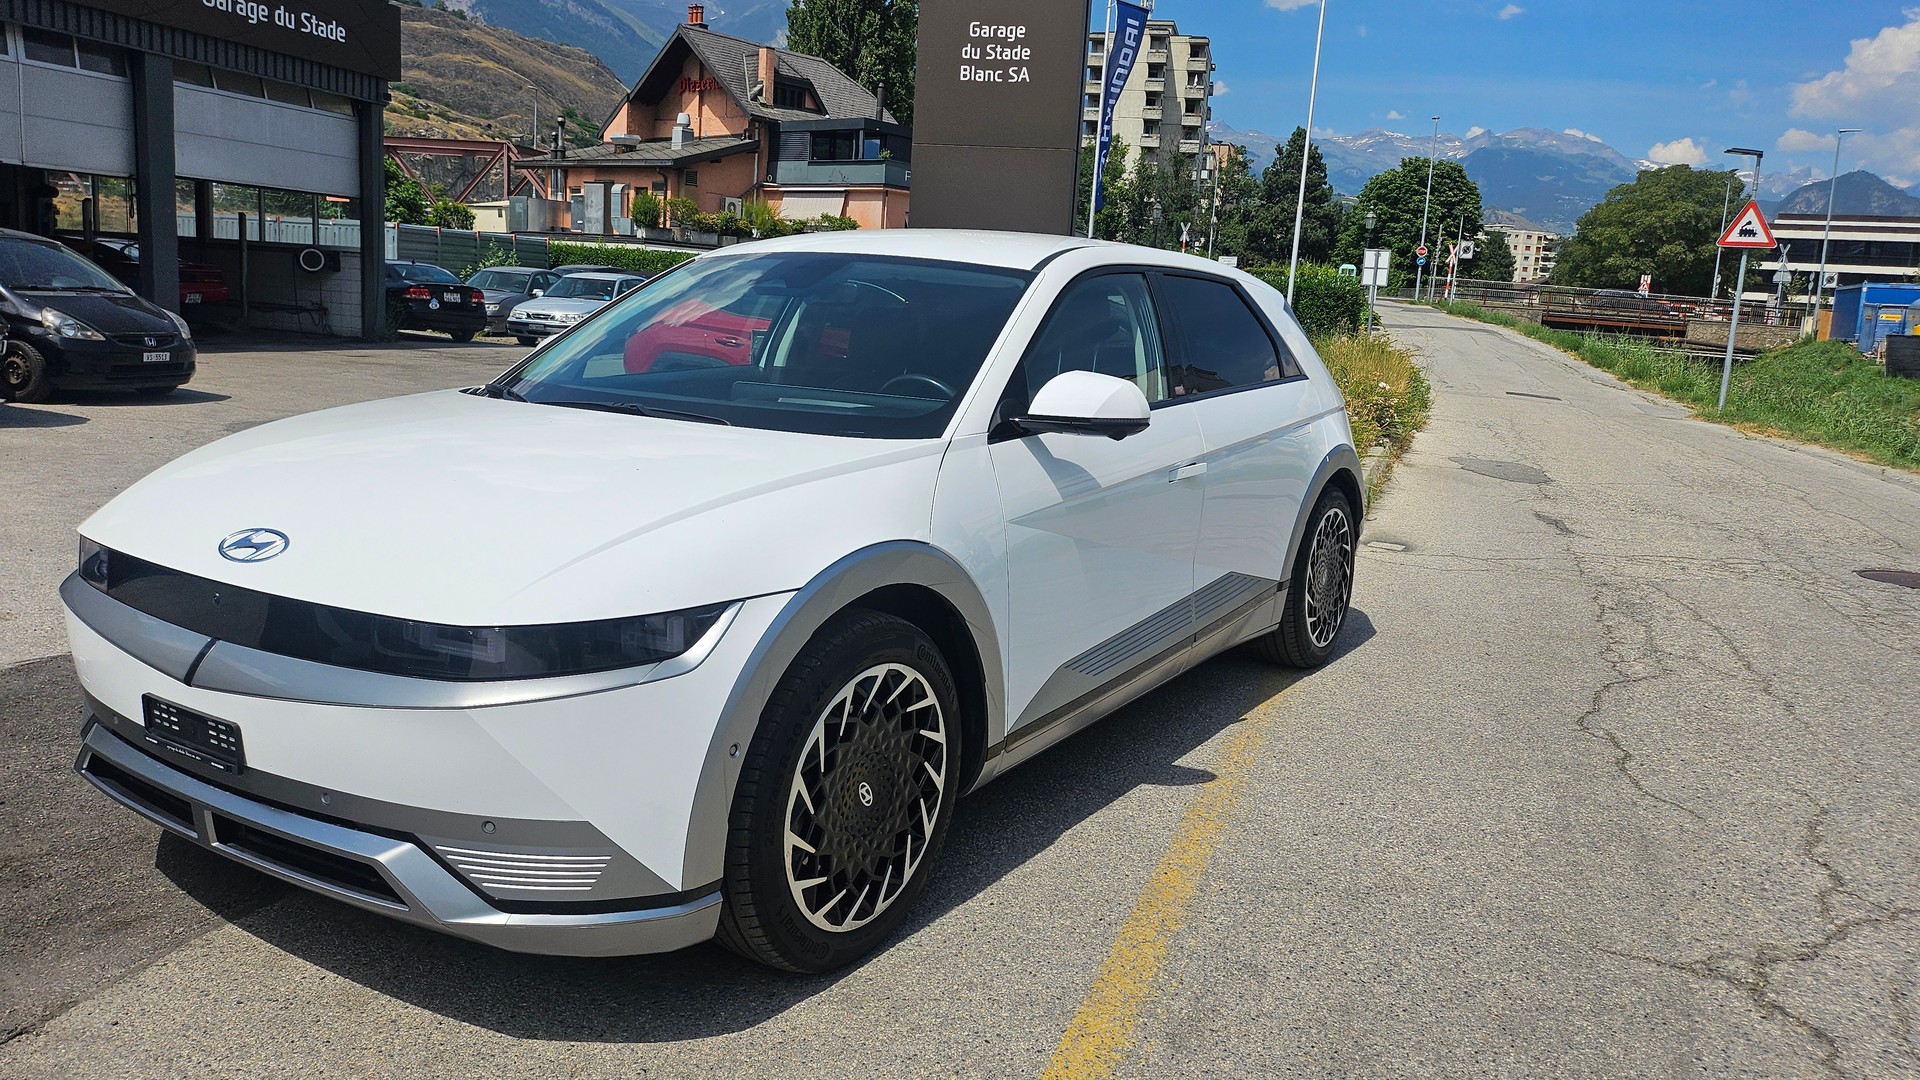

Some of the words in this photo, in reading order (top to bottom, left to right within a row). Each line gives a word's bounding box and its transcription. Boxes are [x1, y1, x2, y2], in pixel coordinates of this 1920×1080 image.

[275, 6, 295, 29] du
[301, 12, 346, 43] Stade
[969, 22, 1026, 42] Garage
[961, 43, 981, 60] du
[985, 44, 1031, 61] Stade
[960, 65, 1003, 82] Blanc
[1008, 66, 1030, 83] SA
[917, 644, 952, 696] Continental
[780, 913, 830, 960] Continental
